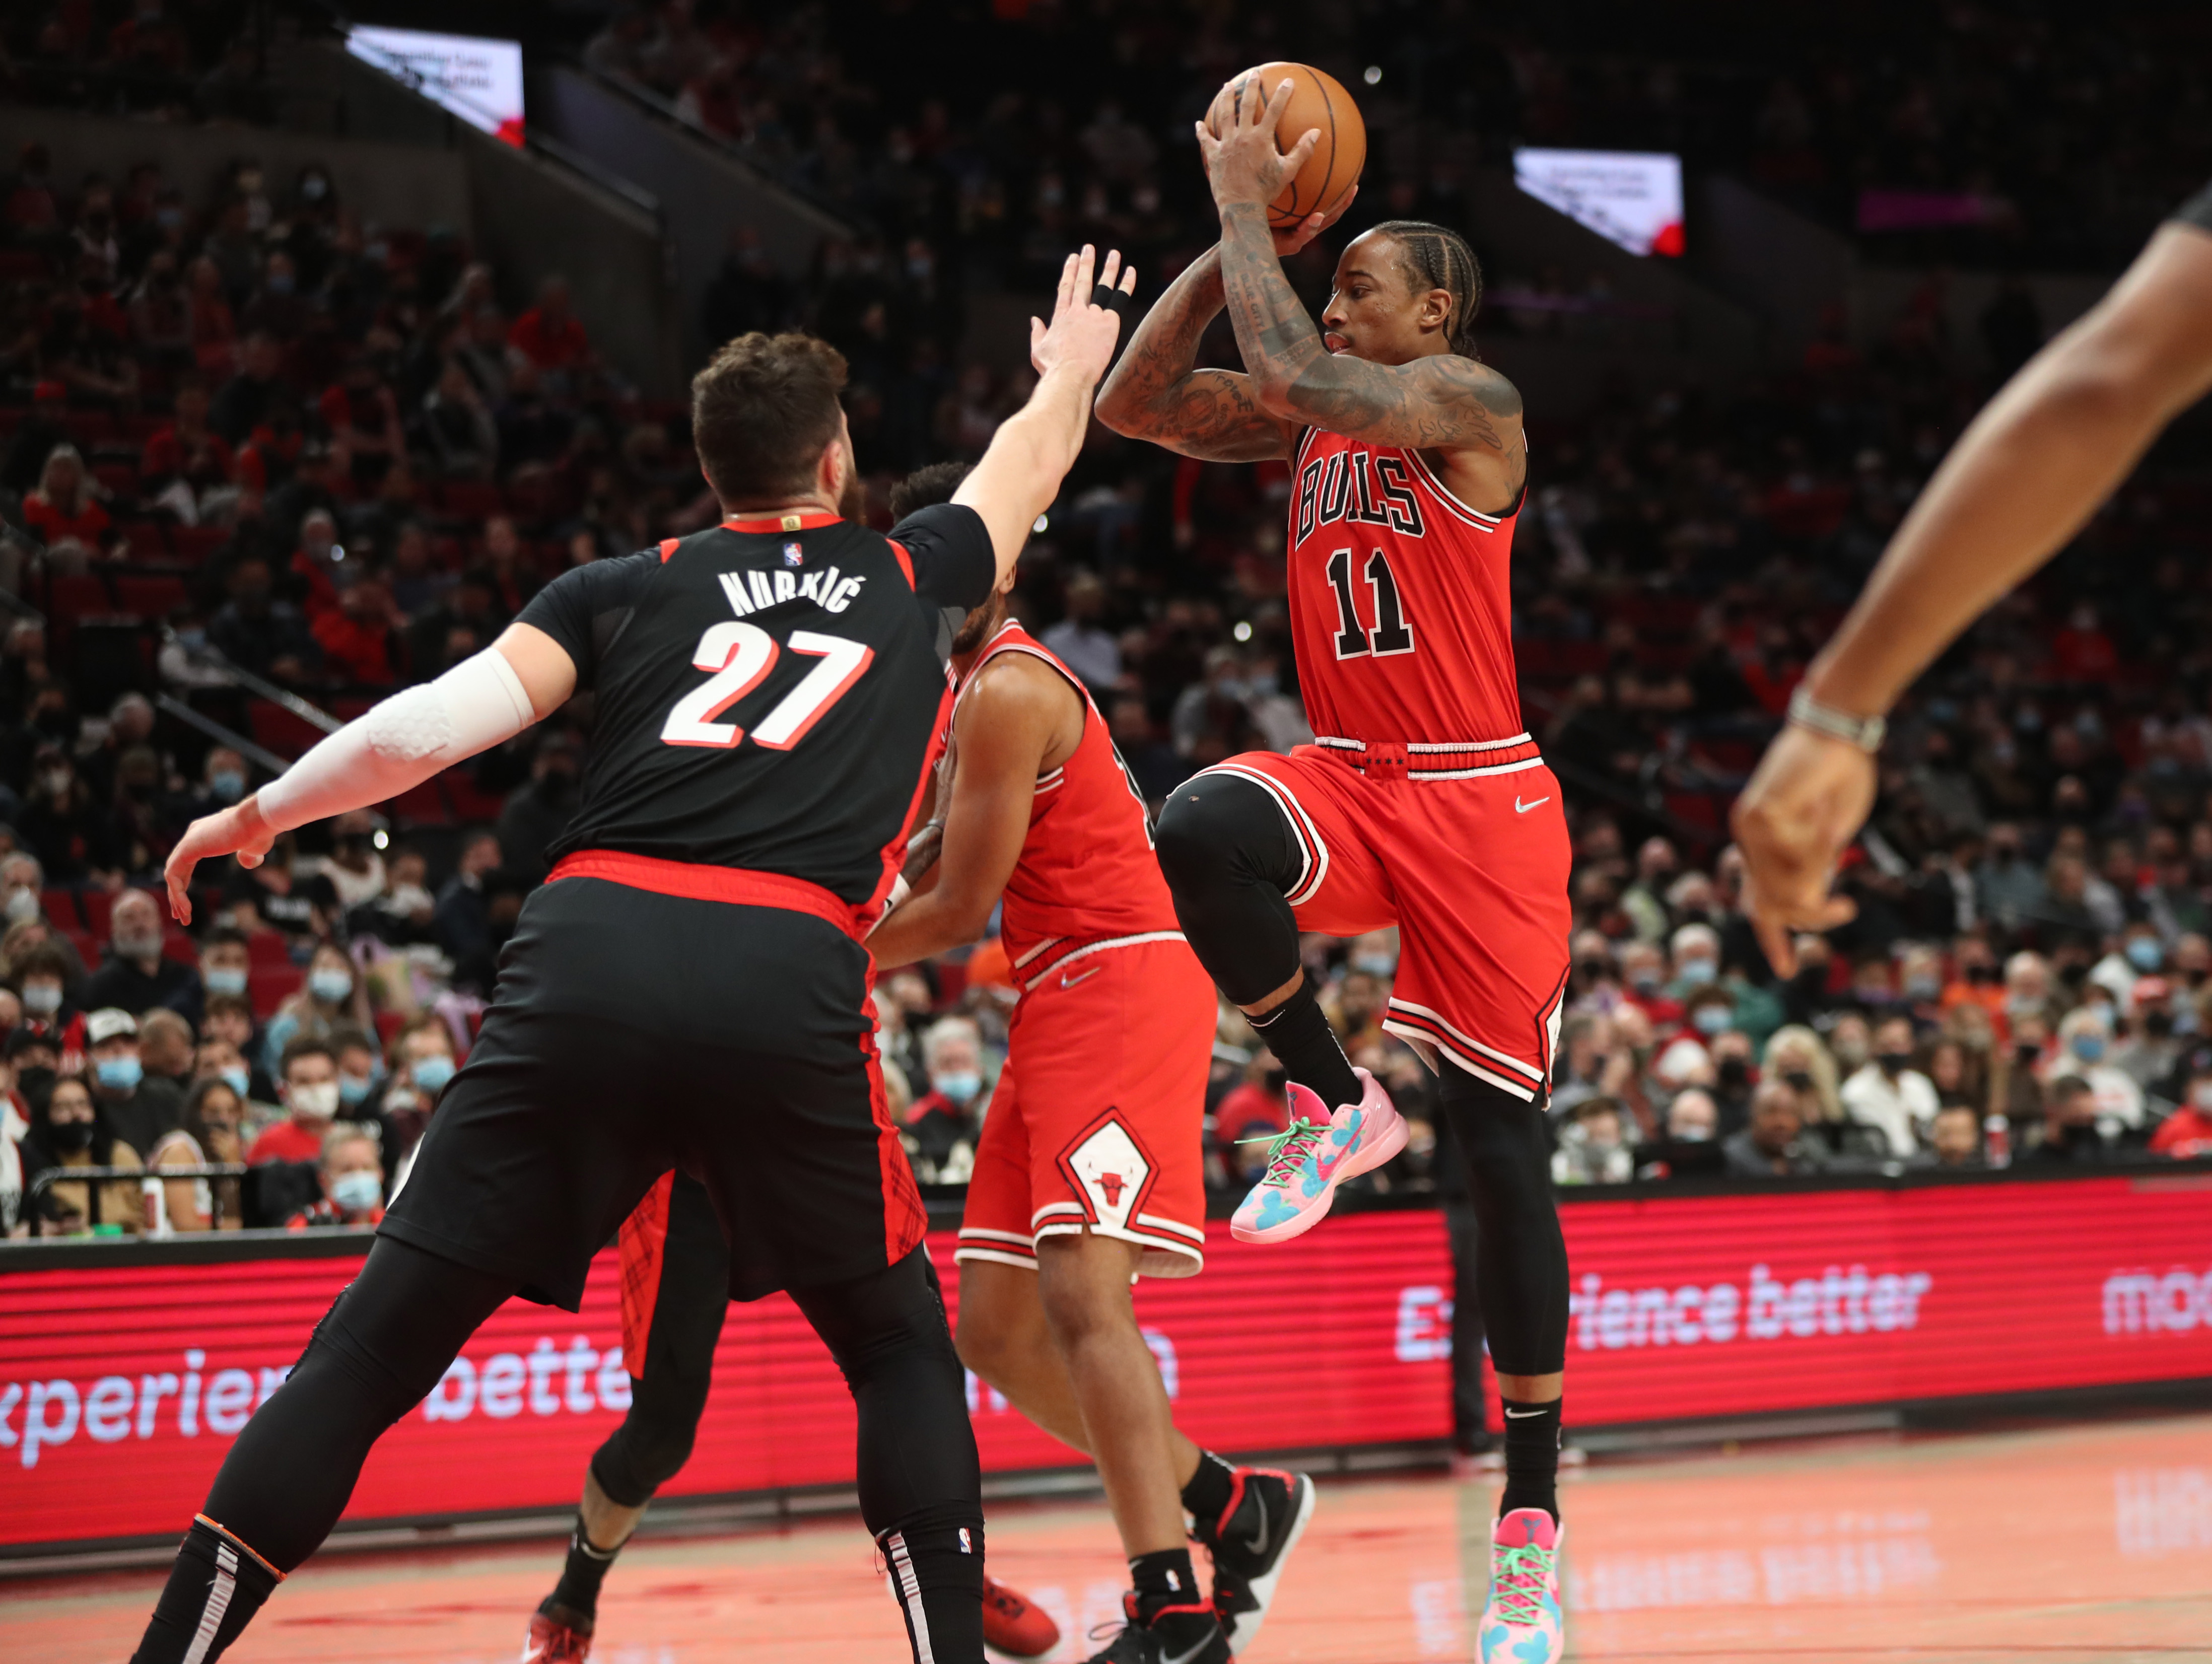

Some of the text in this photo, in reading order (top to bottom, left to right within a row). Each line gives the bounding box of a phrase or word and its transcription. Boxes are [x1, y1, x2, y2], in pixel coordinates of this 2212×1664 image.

[717, 566, 867, 617] NURKIĆ
[1325, 546, 1415, 661] 11
[660, 620, 876, 751] 27
[1395, 1263, 1932, 1362] Eience better
